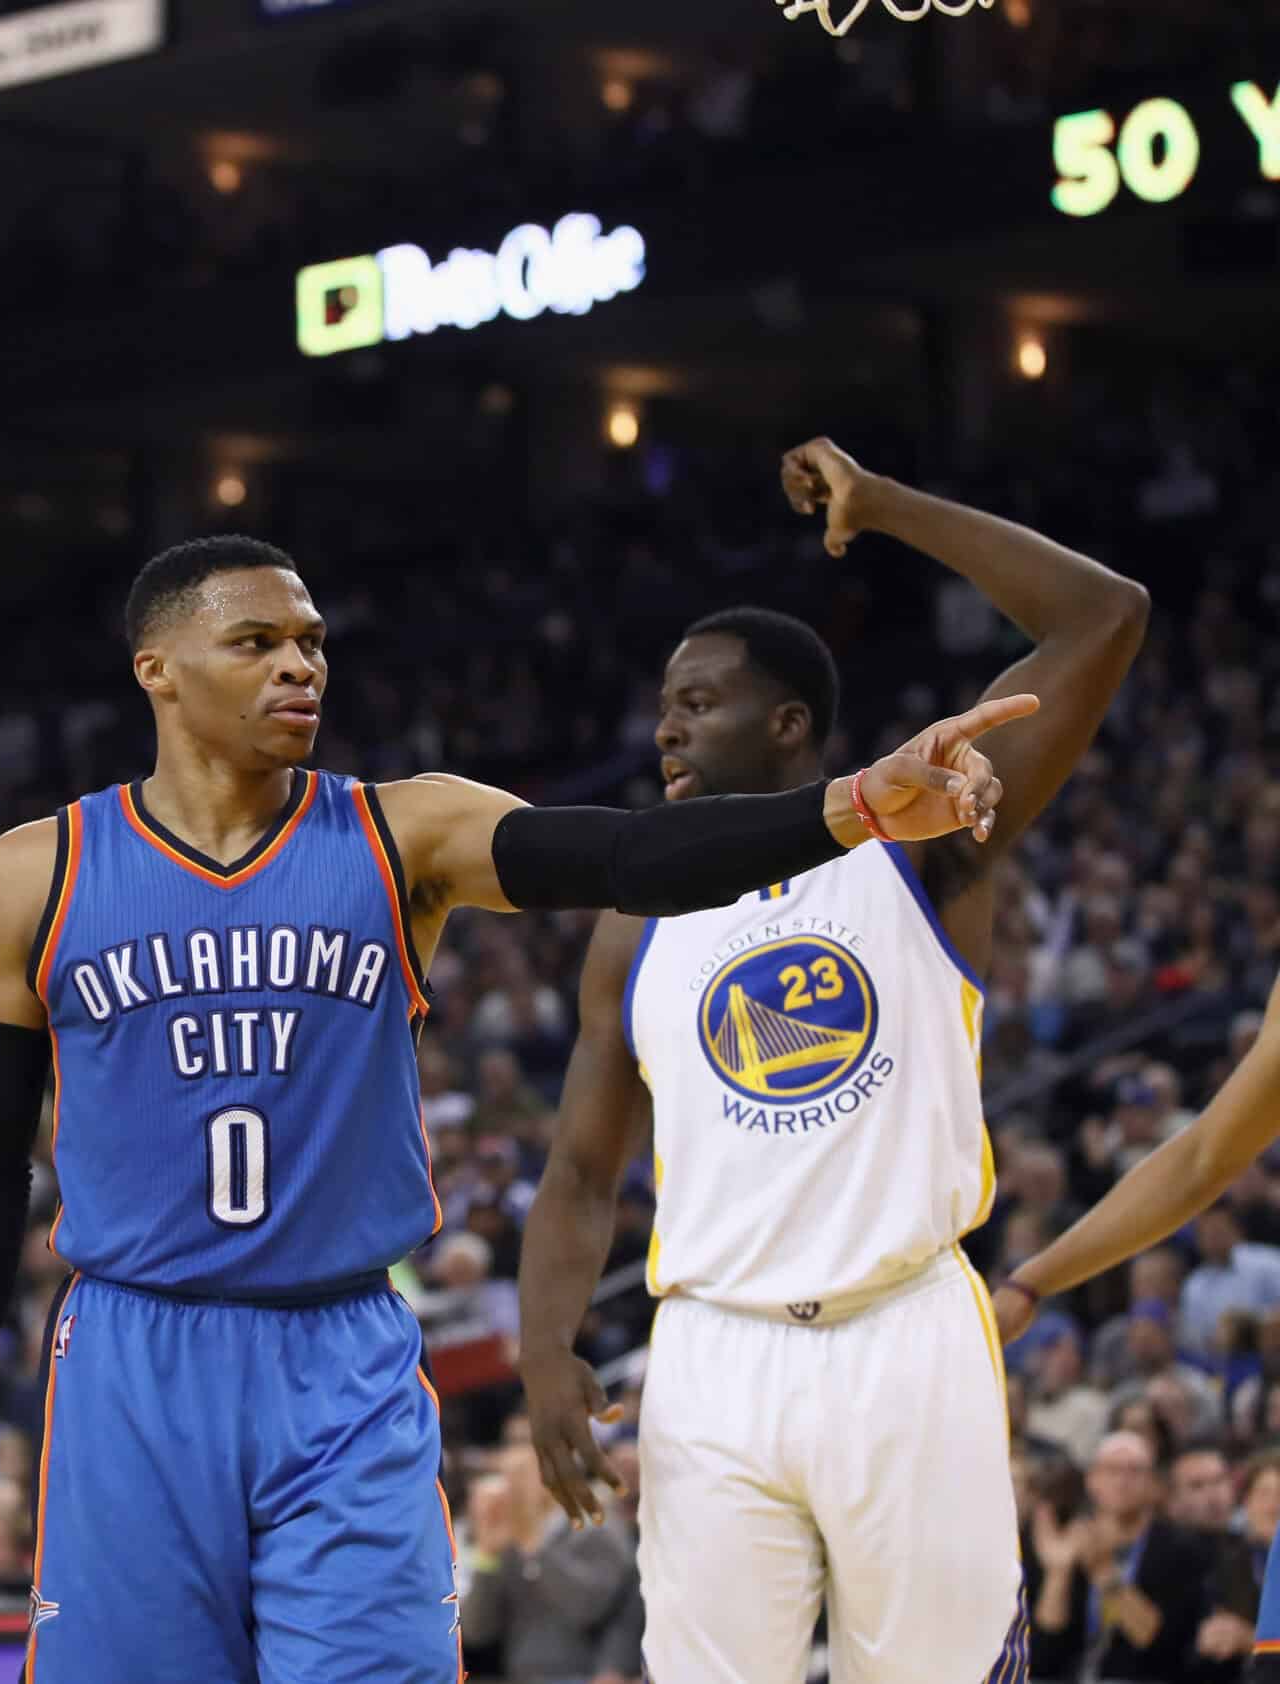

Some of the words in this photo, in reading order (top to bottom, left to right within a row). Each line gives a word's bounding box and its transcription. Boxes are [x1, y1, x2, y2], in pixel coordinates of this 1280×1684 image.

[1050, 97, 1200, 218] 50
[70, 926, 389, 1022] OKLAHOMA
[689, 922, 781, 992] GOLDEN
[791, 917, 865, 951] STATE
[777, 956, 845, 1012] 23
[169, 1009, 300, 1078] CITY
[722, 1051, 894, 1134] WARRIORS
[208, 1107, 268, 1228] 0
